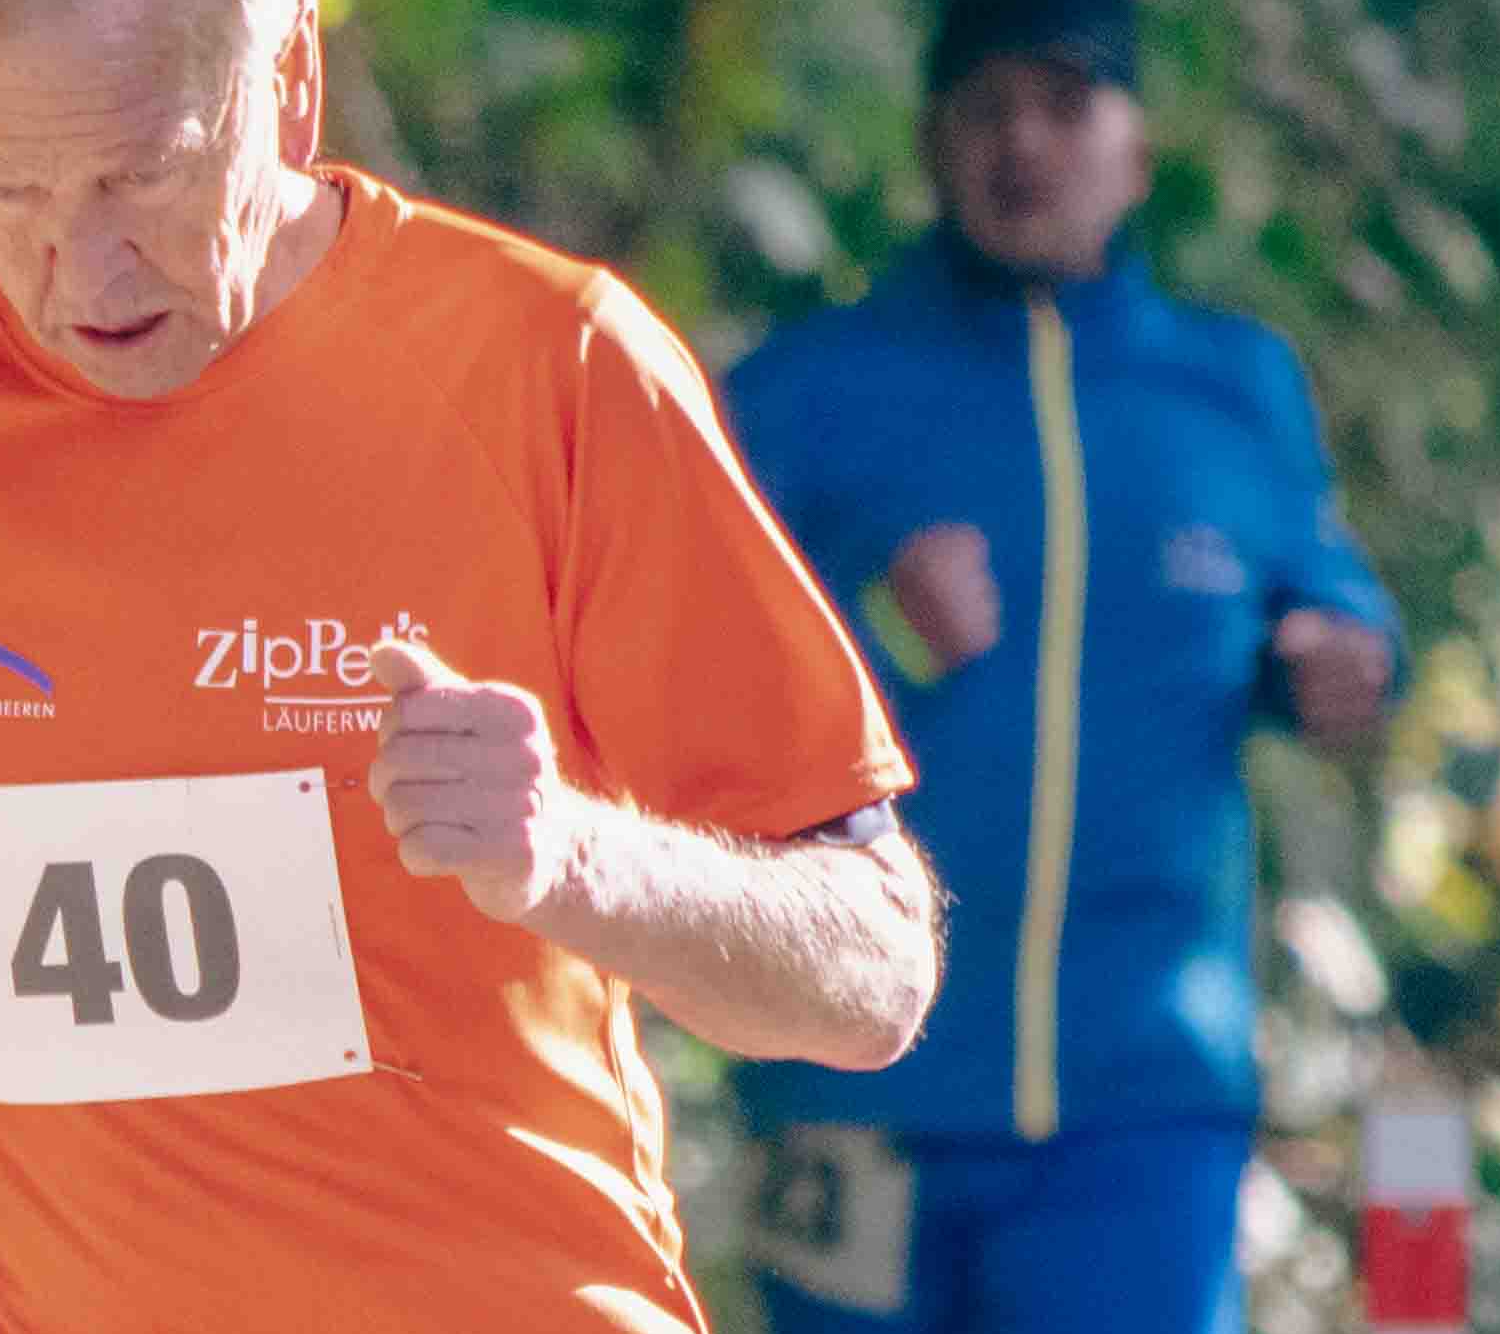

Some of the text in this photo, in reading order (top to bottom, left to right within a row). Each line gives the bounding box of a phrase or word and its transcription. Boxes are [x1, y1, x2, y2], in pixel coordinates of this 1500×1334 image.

[194, 611, 429, 689] ZipPe's
[262, 707, 383, 734] LÄUFERW
[11, 853, 241, 1026] 40
